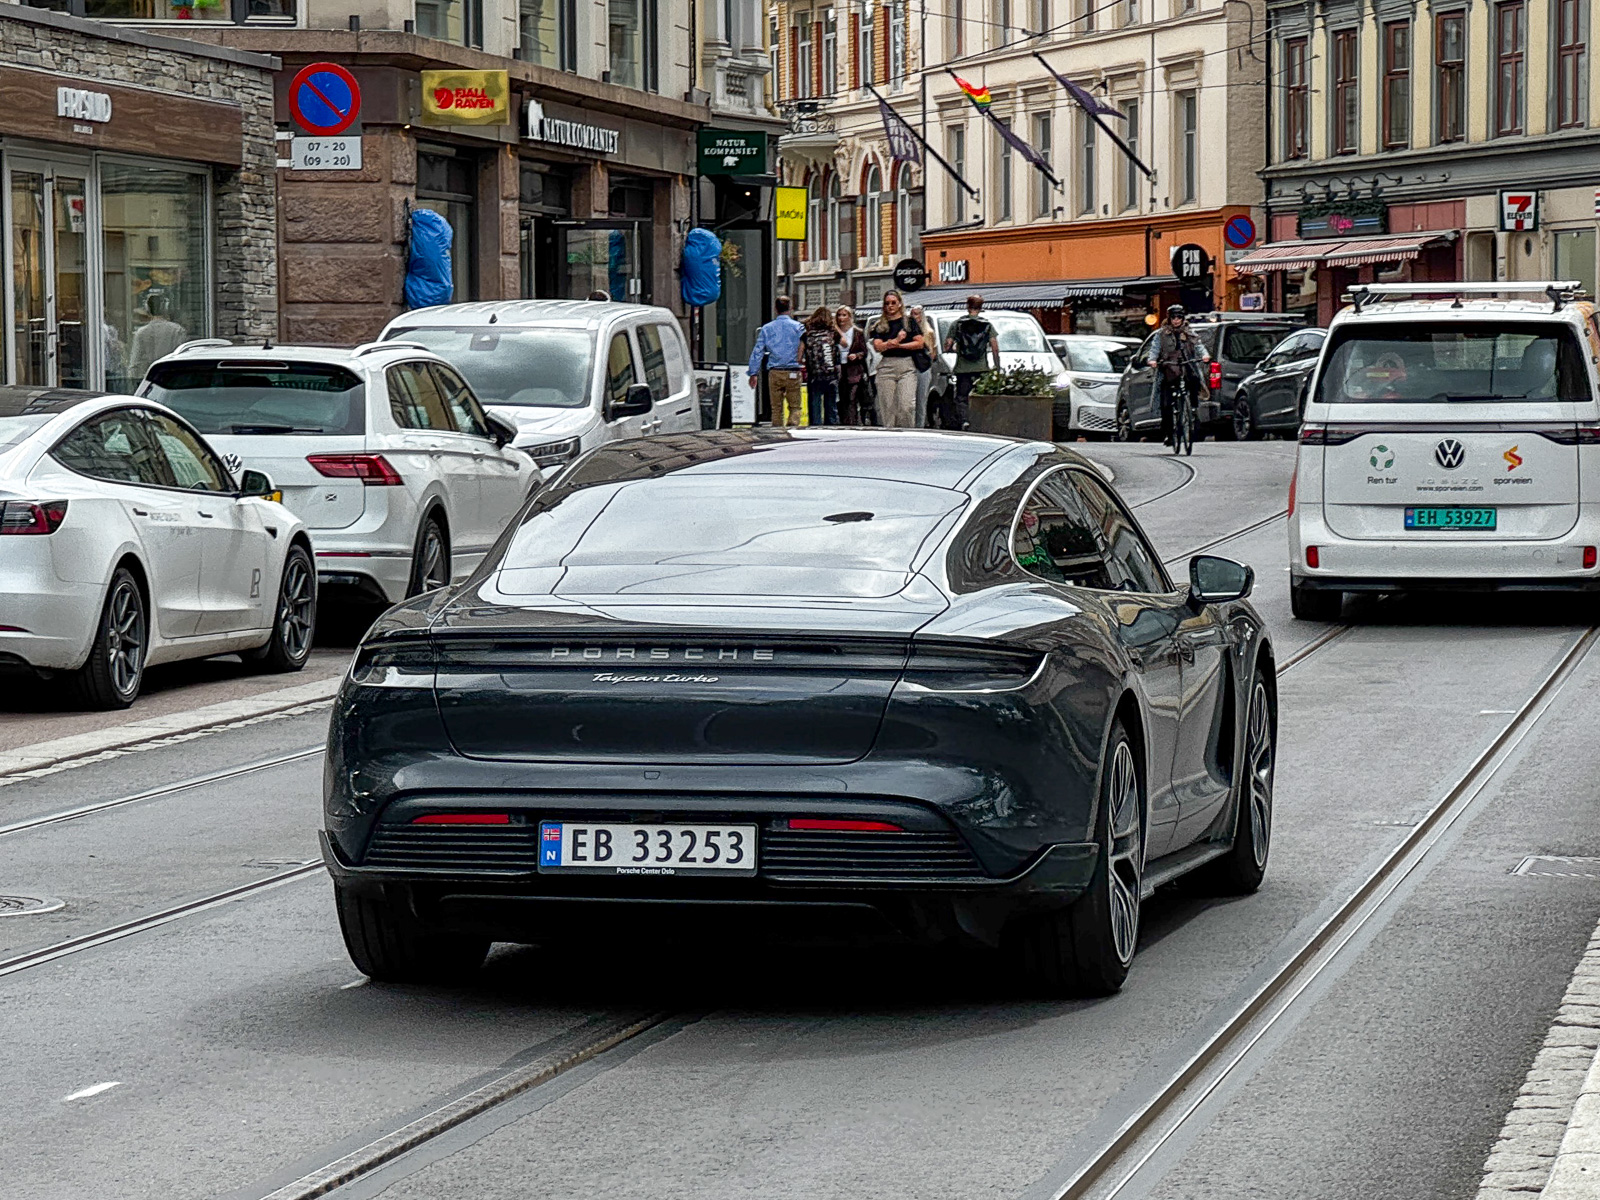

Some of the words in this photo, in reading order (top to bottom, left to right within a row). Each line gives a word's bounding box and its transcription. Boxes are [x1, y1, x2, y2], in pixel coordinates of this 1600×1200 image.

[543, 117, 619, 154] NATURKOMPANIET
[308, 142, 321, 151] 07
[332, 142, 346, 151] 20
[716, 139, 746, 147] NATUR
[704, 147, 758, 155] KOMPANIET
[304, 154, 321, 166] (09
[333, 154, 351, 166] 20)
[1508, 195, 1532, 230] 7
[1182, 249, 1200, 263] PIN
[1418, 511, 1437, 524] EH
[1445, 511, 1493, 525] 53927
[551, 647, 774, 660] PORSCHE
[592, 672, 660, 684] Taycan
[572, 828, 613, 862] EB
[632, 829, 744, 864] 33253
[547, 850, 556, 860] N
[617, 867, 640, 875] Porsche
[641, 867, 661, 875] Center
